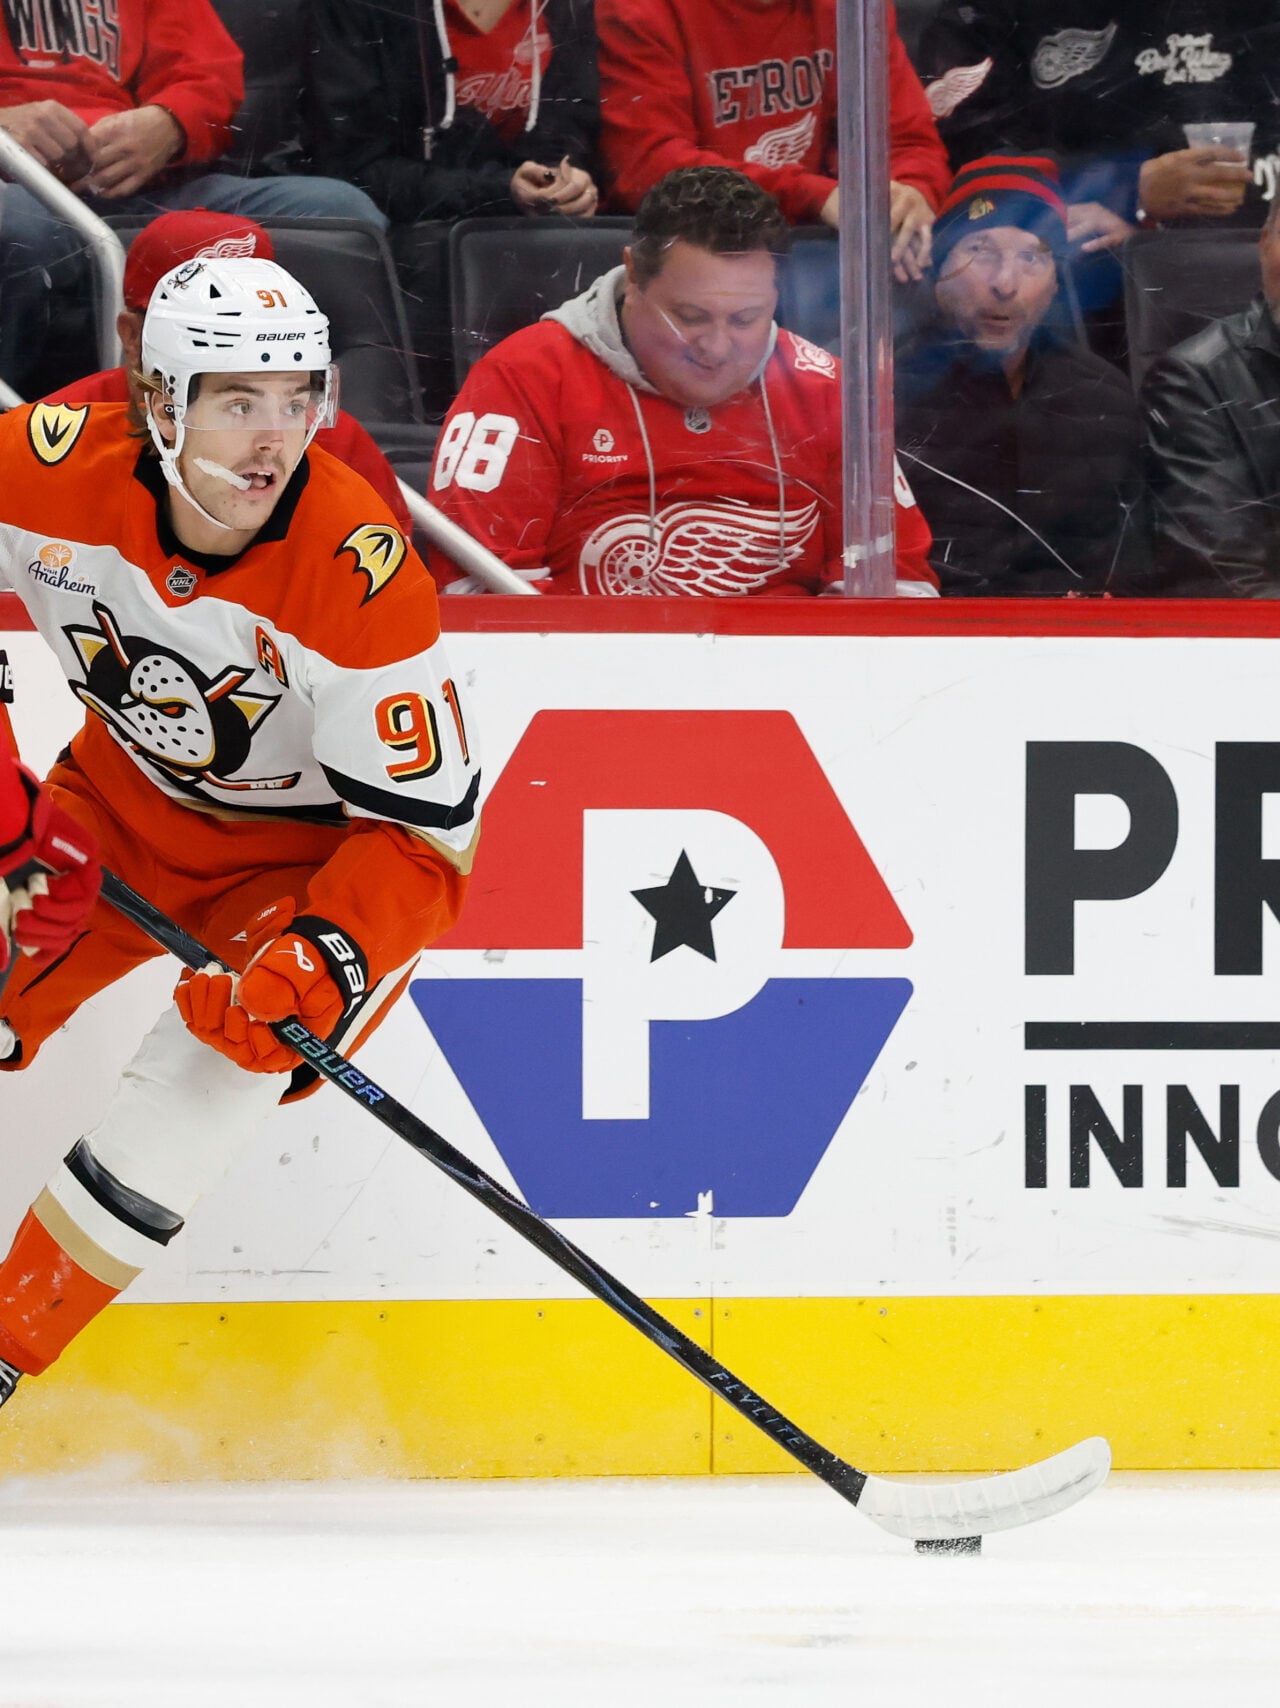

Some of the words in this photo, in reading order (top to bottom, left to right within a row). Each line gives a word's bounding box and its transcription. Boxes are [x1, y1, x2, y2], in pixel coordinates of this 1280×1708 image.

[255, 332, 306, 342] BAUER
[256, 289, 288, 308] 91
[433, 411, 520, 493] 88
[582, 453, 628, 463] PRIORITY
[28, 561, 96, 595] Anaheim
[374, 678, 470, 783] 91
[281, 1022, 385, 1105] BAUER
[1024, 1084, 1280, 1188] INN
[710, 1370, 807, 1449] FLYLITE
